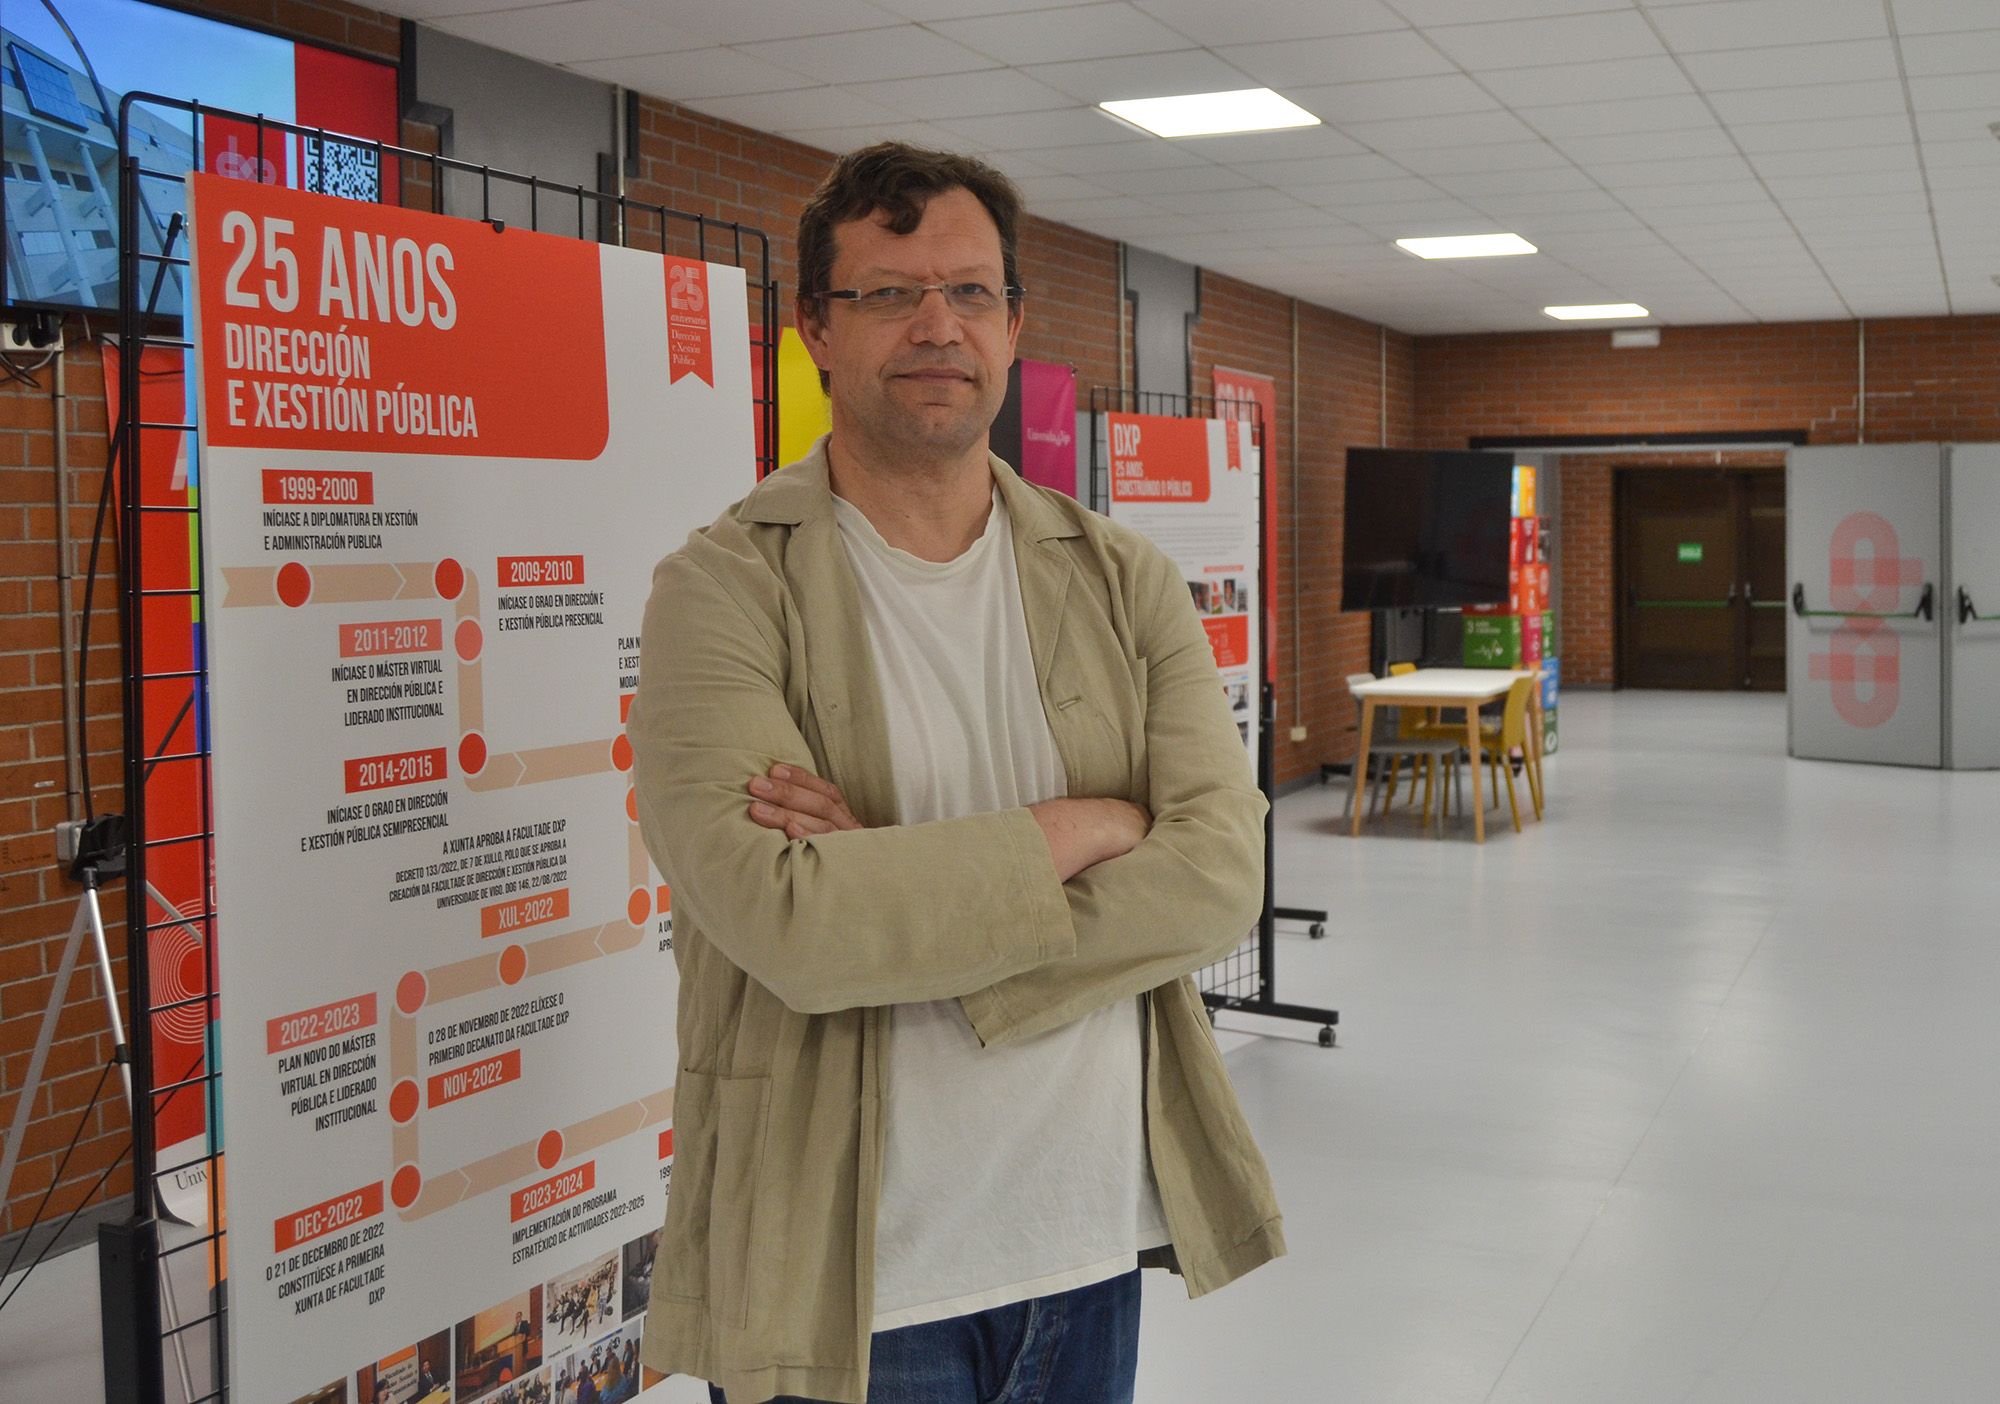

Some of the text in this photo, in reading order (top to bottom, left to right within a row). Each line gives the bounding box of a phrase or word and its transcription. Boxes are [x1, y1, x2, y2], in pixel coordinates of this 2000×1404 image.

[221, 211, 457, 330] 25 ANOS
[670, 265, 704, 311] 25
[225, 322, 370, 380] DIRECCIÓN
[229, 378, 478, 438] E XESTIÓN PÚBLICA
[1114, 423, 1141, 456] DXP
[1115, 461, 1125, 477] 25
[279, 476, 358, 501] 1999-2000
[263, 509, 418, 527] INÍCIASE A DIPLOMATURA EN XESTIÓN
[264, 532, 382, 550] E ADMINISTRACIÓN PUBLICA
[511, 560, 573, 582] 2009-2010
[498, 591, 604, 610] INÍCIASE O GRAO EN DIRECCIÓN E
[355, 625, 428, 652] 2011-2012
[499, 612, 603, 631] E XESTIÓN PÚBLICA PRESENCIAL
[618, 637, 635, 650] PLAN
[332, 659, 442, 681] INÍCIASE O MÁSTER VIRTUAL
[619, 655, 640, 669] E XEST
[347, 680, 443, 703] EN DIRECCIÓN PÚBLICA E
[619, 675, 640, 688] MODA
[345, 702, 444, 726] LIDERADO INSTITUCIONAL
[360, 755, 433, 786] 2014-2015
[327, 789, 448, 824] INÍCIASE O GRAO EN DIRECCIÓN
[301, 813, 449, 852] E XESTIÓN PÚBLICA SEMIPRESENCIAL
[443, 819, 566, 855] A XUNTA APROBA A FACULTADE DXP
[389, 854, 566, 902] CREACIÓN DA FACULTADE DE DIRECCIÓN E XESTIÓN PÚBLICA DA
[396, 838, 566, 883] DECRETO 133/2022, DE 7 DE XULLO, POLO QUE SE APROBA A
[437, 889, 479, 909] UNIVERSIDADE
[481, 887, 489, 899] DE
[505, 881, 517, 893] DOG
[499, 897, 553, 929] XUL-2022
[659, 921, 663, 933] A
[281, 1003, 360, 1046] 2022-2023
[428, 992, 564, 1045] O 28 DE NOVEMBRO DE 2022 ELÍXESE O
[279, 1032, 376, 1073] PLAN NOVO DO MÁSTER
[429, 1011, 569, 1066] PRIMEIRO DECANATO DA FACULTADE DXP
[281, 1053, 376, 1096] VIRTUAL EN DIRECCIÓN
[443, 1060, 503, 1099] NOV-2022
[291, 1077, 377, 1116] PÚBLICA E LIDERADO
[315, 1099, 377, 1131] INSTITUCIONAL
[175, 1167, 207, 1190] Univ
[522, 1170, 583, 1214] 2023-2024
[294, 1195, 363, 1241] DEC-2022
[512, 1189, 617, 1245] IMPLEMENTACIÓN DO PROGRAMA
[512, 1195, 645, 1264] ESTRATÉXICO DE ACTIVIDADES 2022-2025
[266, 1222, 384, 1281] O 21 DE DECEMBRO DE 2022
[278, 1243, 385, 1299] CONSTITÚESE A PRIMEIRA
[295, 1264, 385, 1315] XUNTA DE FACULTADE
[369, 1286, 385, 1305] DXP
